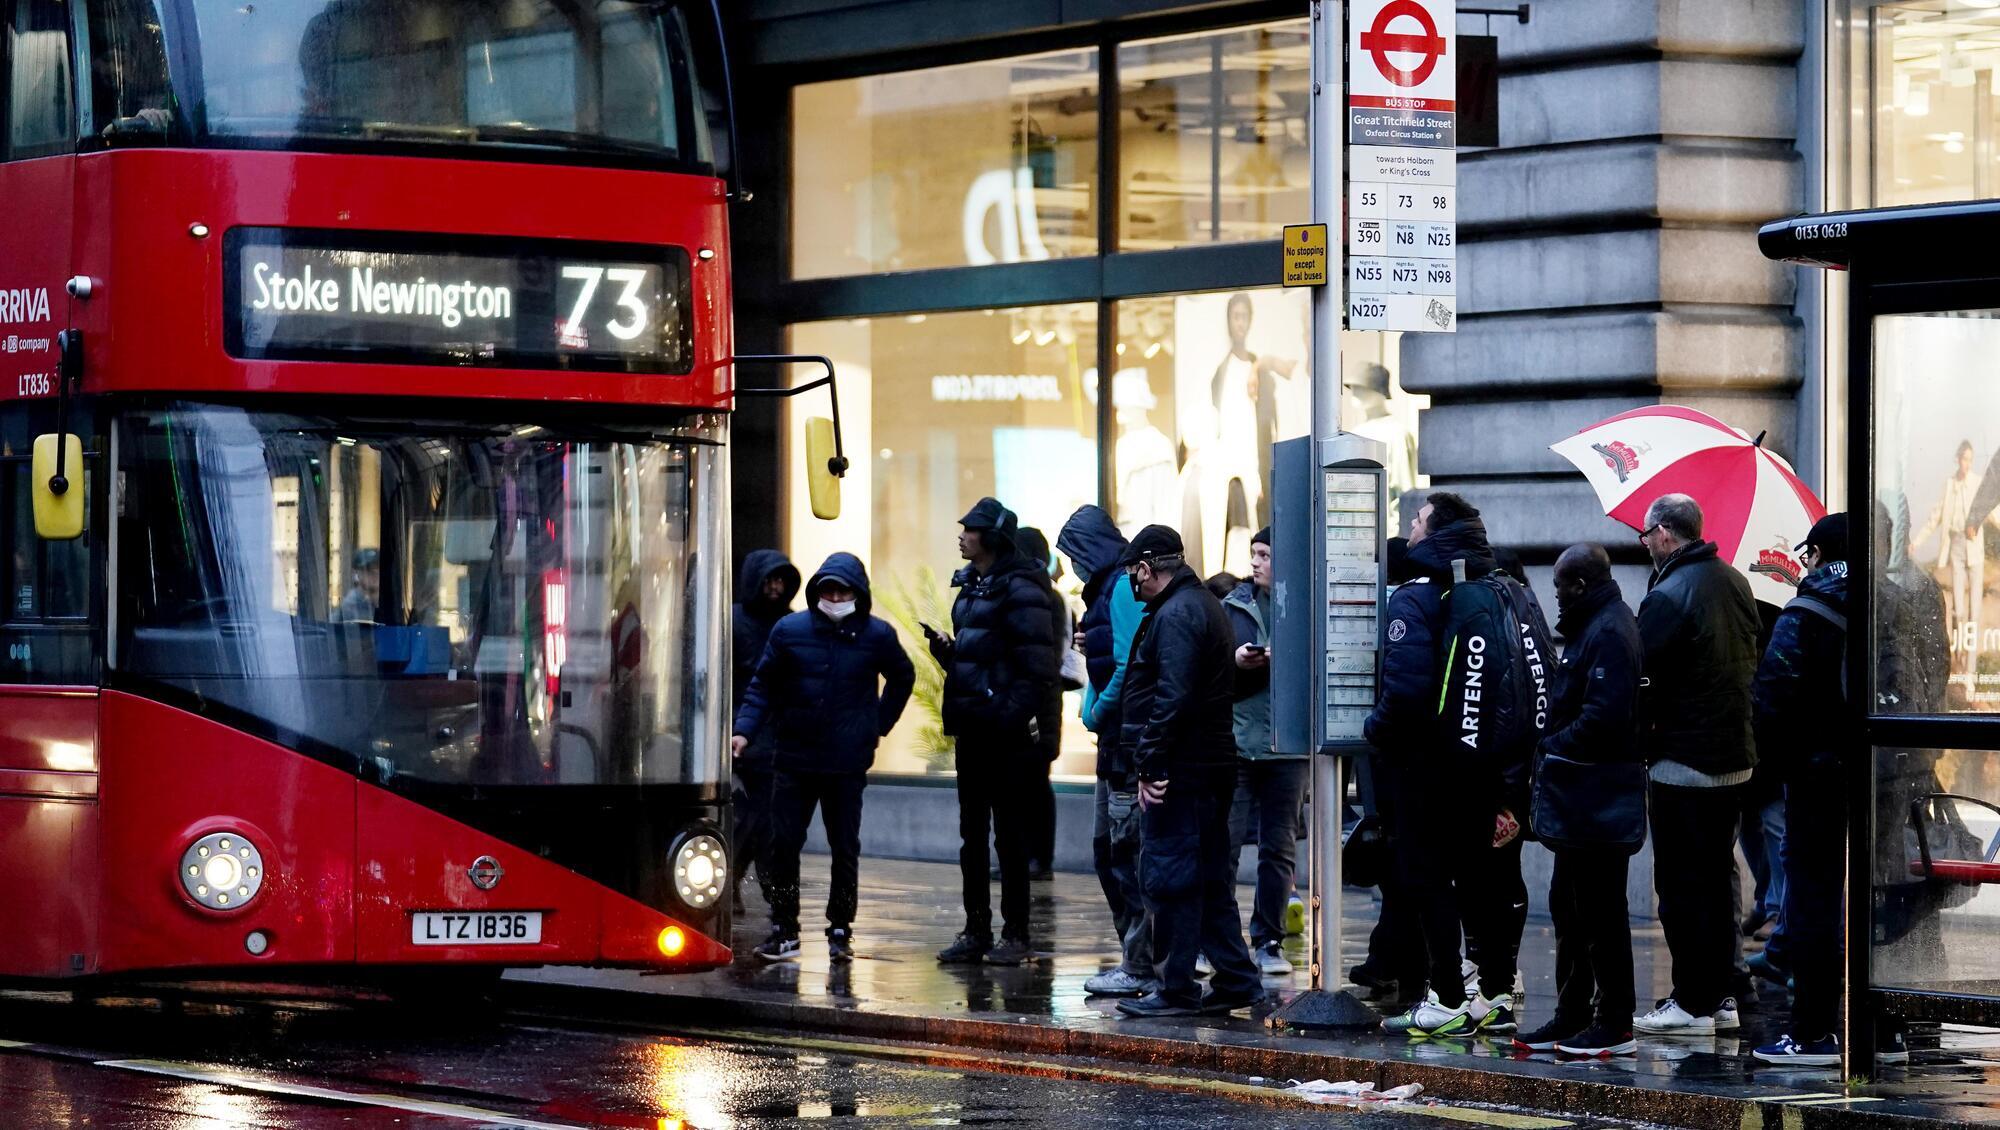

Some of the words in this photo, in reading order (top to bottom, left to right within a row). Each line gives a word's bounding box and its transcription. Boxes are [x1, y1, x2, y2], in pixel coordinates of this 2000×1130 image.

[1385, 98, 1402, 107] BUS
[1403, 99, 1426, 108] STOP
[1353, 115, 1381, 125] Great
[1382, 115, 1425, 127] Titchfield
[1426, 118, 1452, 129] Street
[1365, 129, 1390, 138] Oxford
[1390, 130, 1411, 138] Circus
[1412, 131, 1434, 140] Station
[1376, 155, 1405, 164] towards
[1406, 156, 1434, 165] Holborn
[1389, 167, 1410, 177] King's
[1411, 168, 1431, 177] Cross
[1361, 192, 1377, 206] 55
[1398, 194, 1413, 208] 73
[1432, 196, 1447, 210] 98
[1357, 230, 1381, 243] 390
[1396, 231, 1414, 245] N8
[1795, 223, 1819, 241] 0133
[1821, 222, 1848, 239] 0628
[1427, 233, 1451, 247] N25
[1286, 247, 1296, 256] No
[1297, 246, 1324, 257] stopping
[1294, 259, 1316, 270] except
[1287, 271, 1303, 281] local
[1303, 271, 1322, 281] buses
[1356, 267, 1382, 281] N55
[1393, 268, 1418, 282] N73
[1428, 270, 1452, 284] N98
[253, 262, 339, 312] Stoke
[351, 266, 512, 328] Newington
[0, 287, 51, 323] RRIVA
[561, 266, 648, 341] 73
[1352, 303, 1387, 318] N207
[19, 338, 51, 353] company
[18, 372, 50, 396] LT836
[1519, 622, 1548, 729] ARTENGO
[1460, 635, 1487, 748] ARTENGO
[426, 915, 470, 940] LTZ
[477, 915, 527, 939] 1836
